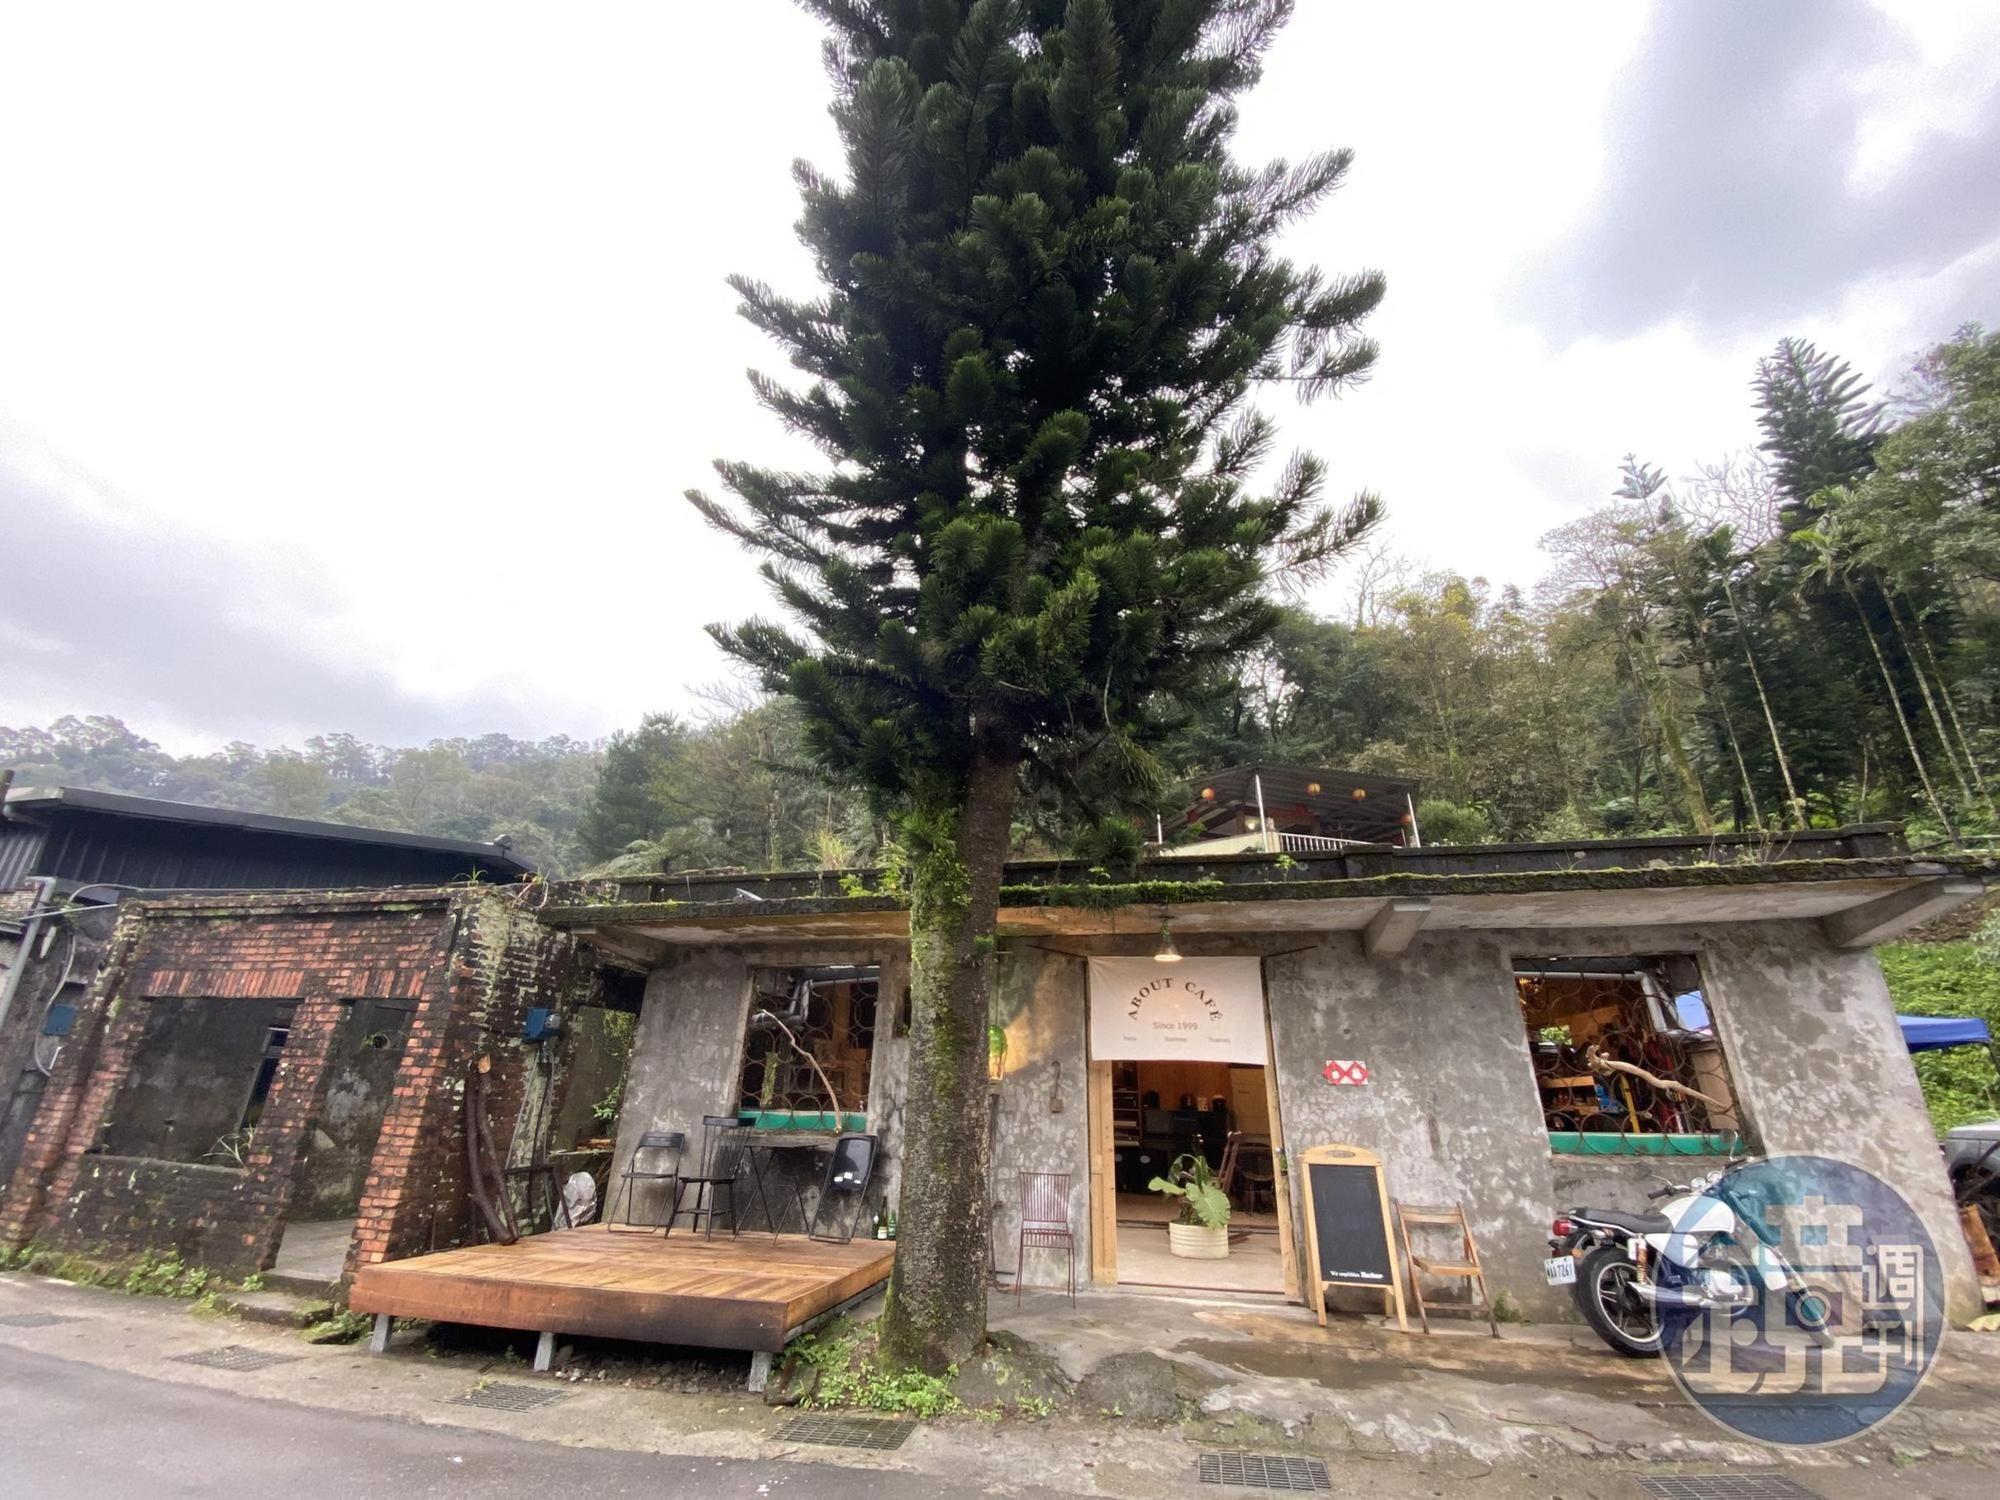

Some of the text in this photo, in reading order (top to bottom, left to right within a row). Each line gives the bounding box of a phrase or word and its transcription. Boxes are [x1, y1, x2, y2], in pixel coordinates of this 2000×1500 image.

[1127, 977, 1174, 1021] ABOUT
[1152, 1021, 1199, 1031] Since 1999
